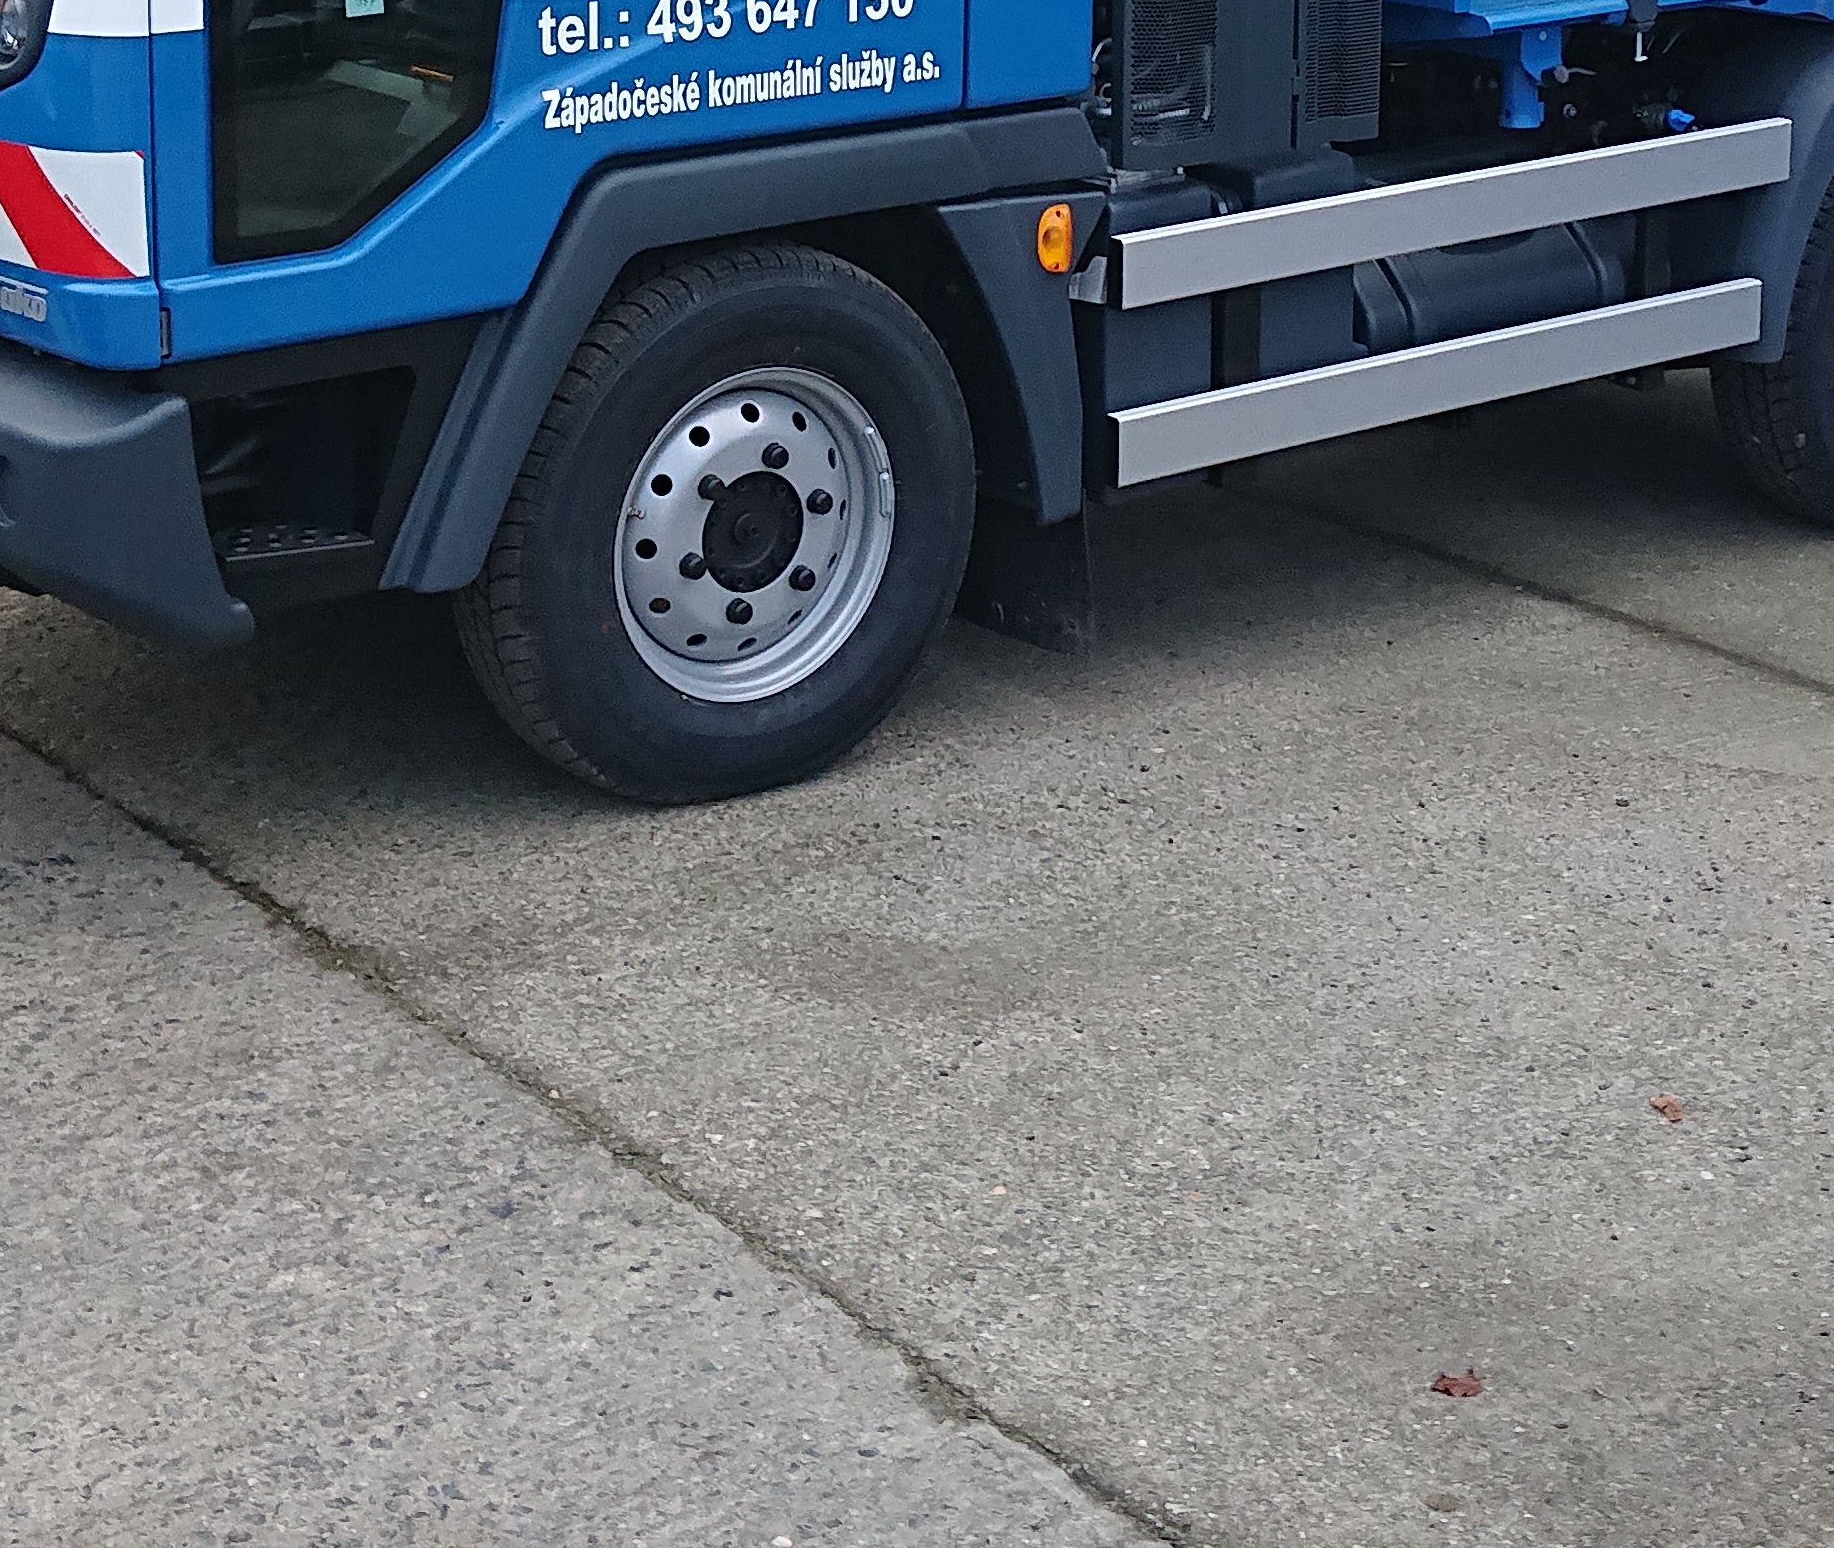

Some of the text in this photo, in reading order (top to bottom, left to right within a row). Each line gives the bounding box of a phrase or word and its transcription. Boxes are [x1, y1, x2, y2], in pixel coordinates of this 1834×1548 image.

[542, 49, 940, 133] Západočeské komunální služby a.s.
